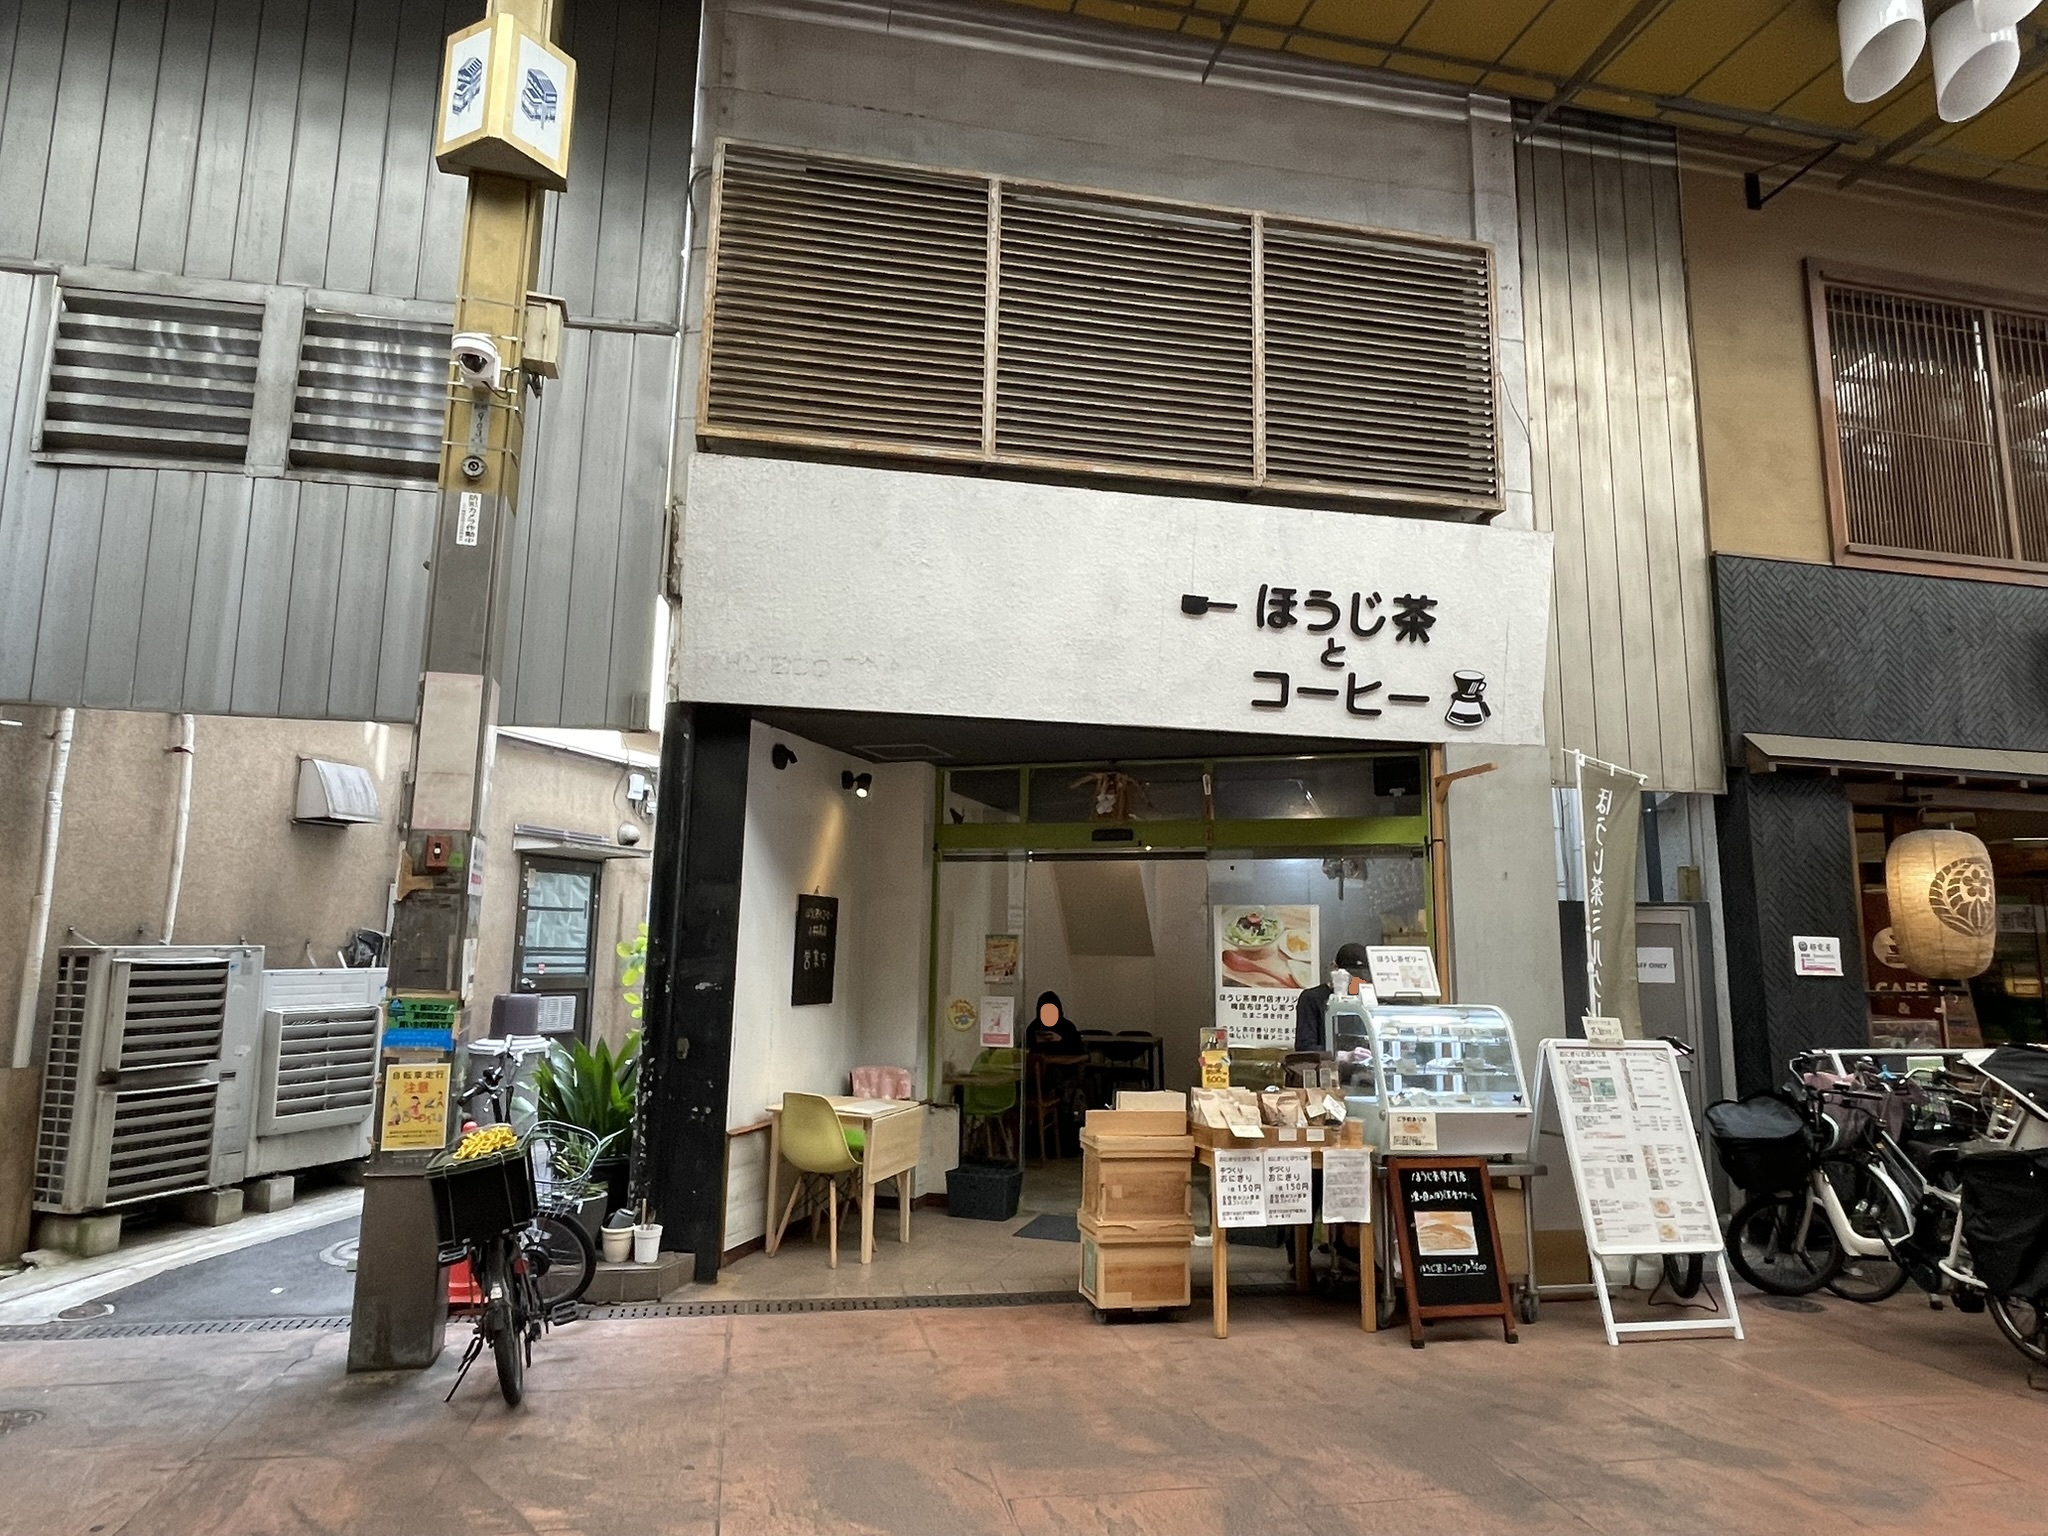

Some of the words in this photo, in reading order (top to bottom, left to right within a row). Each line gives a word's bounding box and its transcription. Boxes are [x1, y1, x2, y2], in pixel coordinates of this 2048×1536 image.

[1255, 583, 1440, 645] ほうじ茶
[1319, 637, 1346, 668] と
[1250, 670, 1431, 718] コーヒー
[1875, 981, 1929, 999] CAFE
[392, 1070, 444, 1080] 自転車走行
[404, 1081, 429, 1094] 注意
[1220, 1174, 1252, 1183] おにぎり
[1268, 1173, 1300, 1182] おにぎり
[1237, 1183, 1262, 1192] 150円
[1286, 1182, 1309, 1191] 150円
